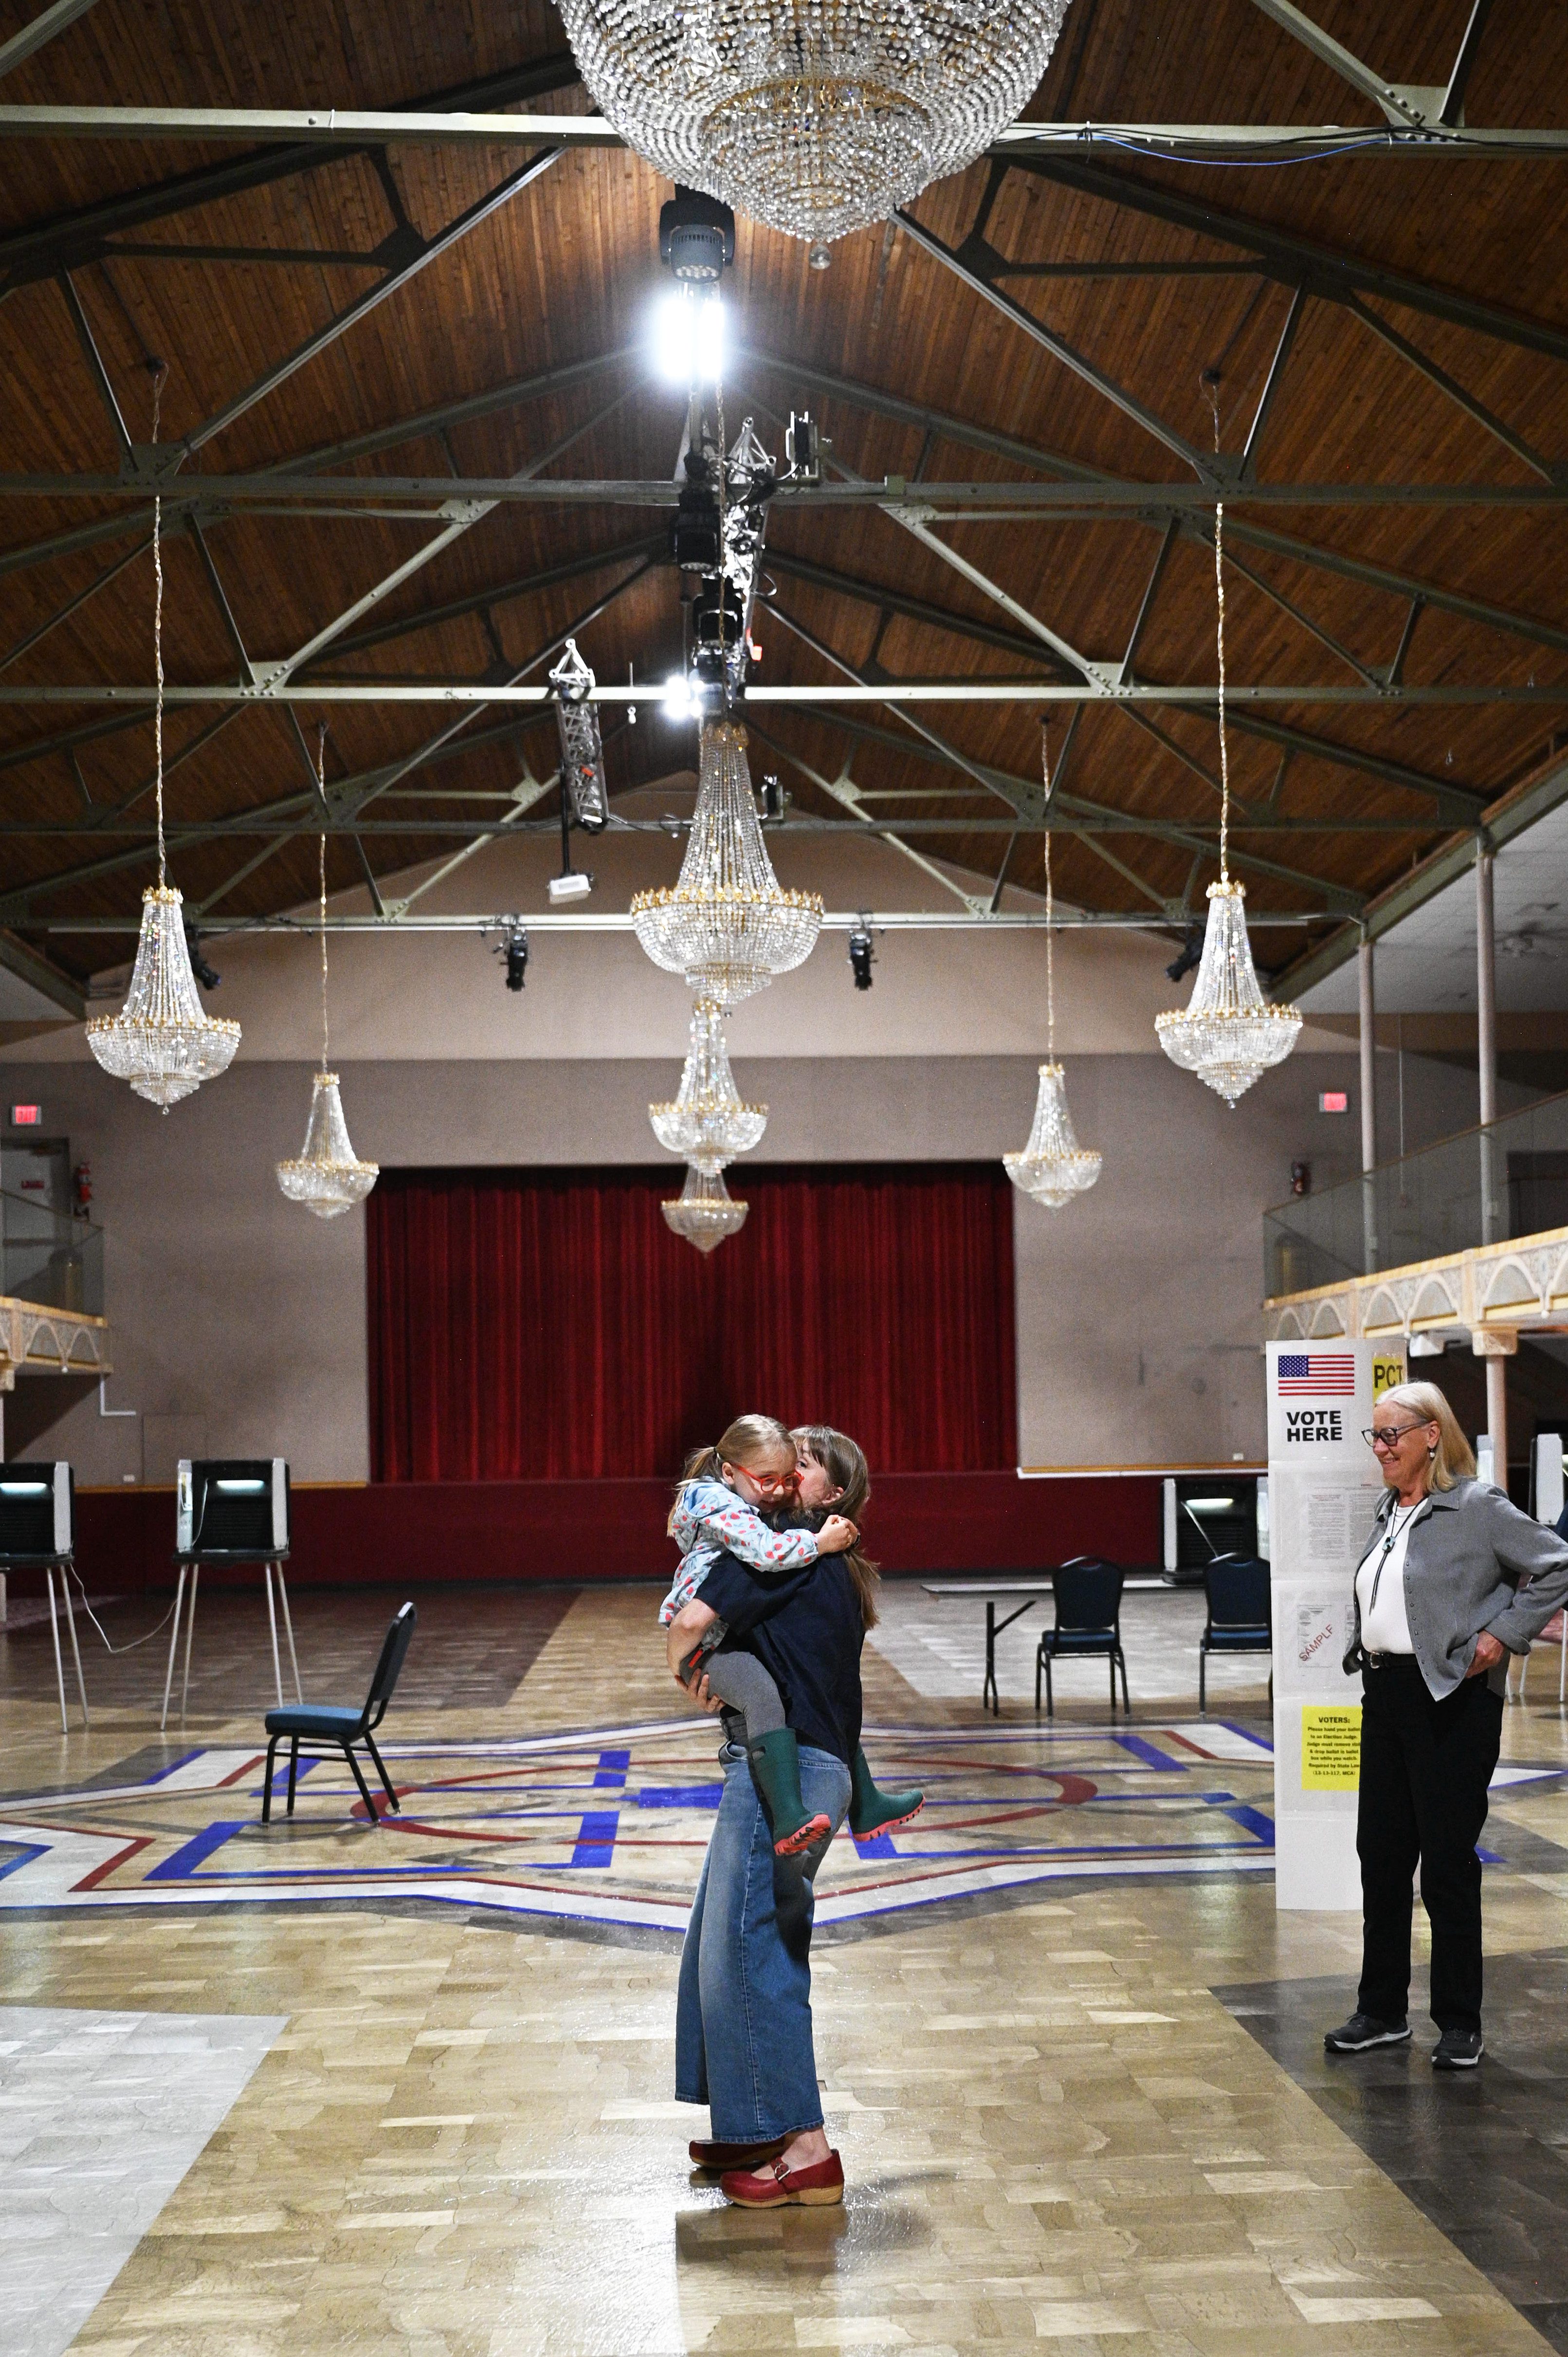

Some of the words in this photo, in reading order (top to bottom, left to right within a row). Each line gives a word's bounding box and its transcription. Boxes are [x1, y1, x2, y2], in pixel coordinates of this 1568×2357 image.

[1374, 1365, 1403, 1388] PCT
[1286, 1411, 1341, 1425] VOTE
[1287, 1426, 1342, 1442] HERE
